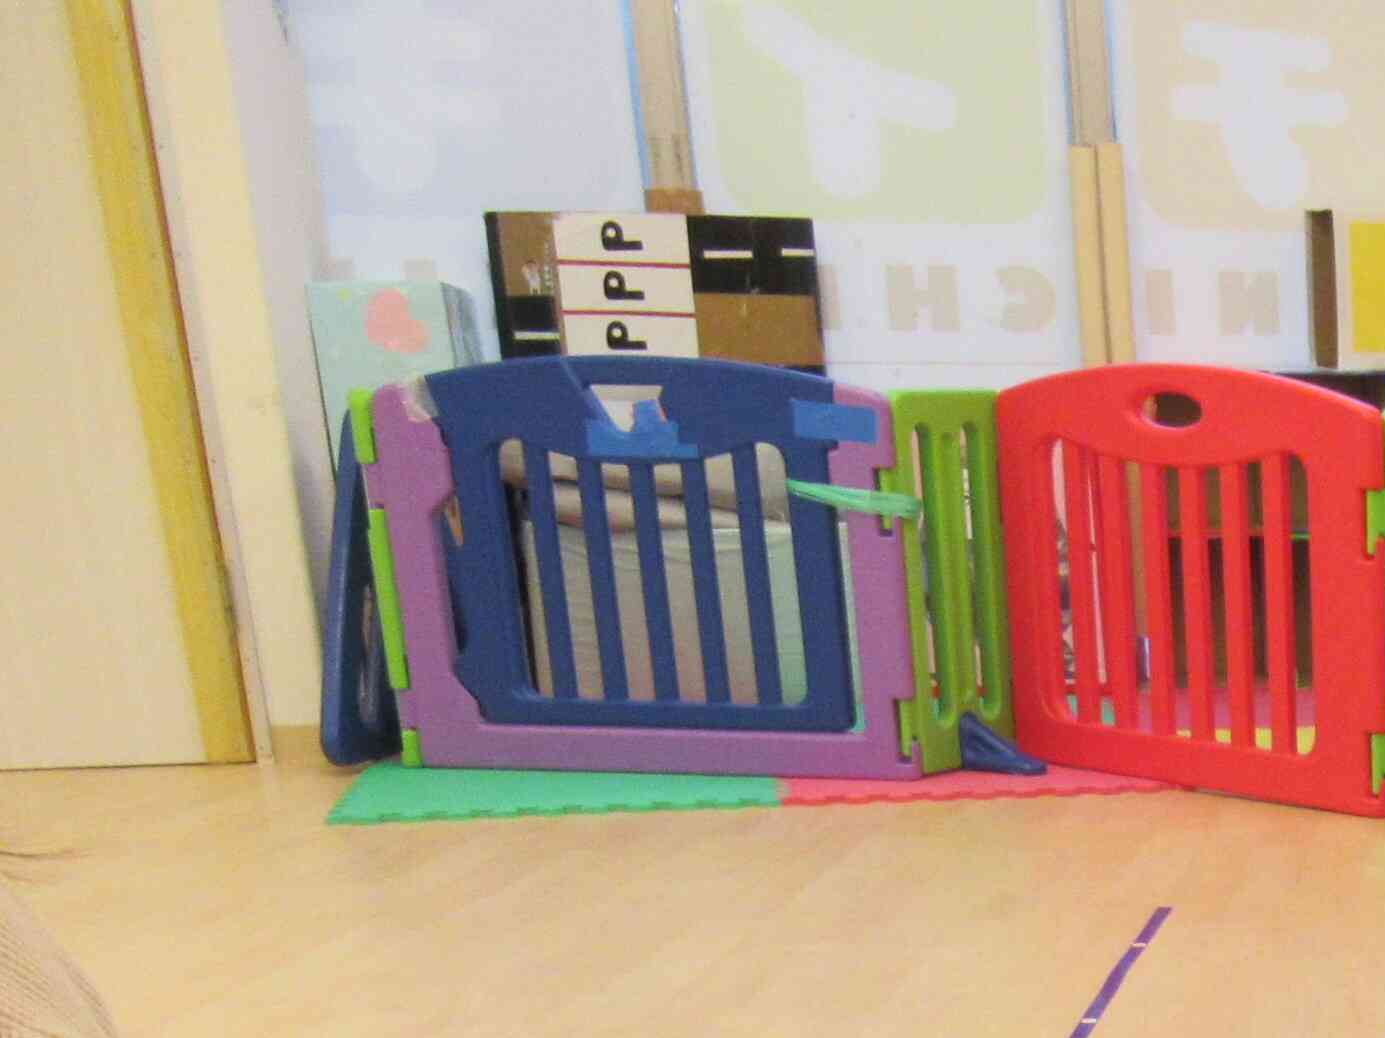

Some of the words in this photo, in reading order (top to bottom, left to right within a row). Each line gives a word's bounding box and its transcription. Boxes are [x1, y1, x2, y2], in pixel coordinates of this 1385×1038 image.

[601, 220, 643, 251] P
[603, 270, 645, 300] P
[606, 320, 648, 350] P
